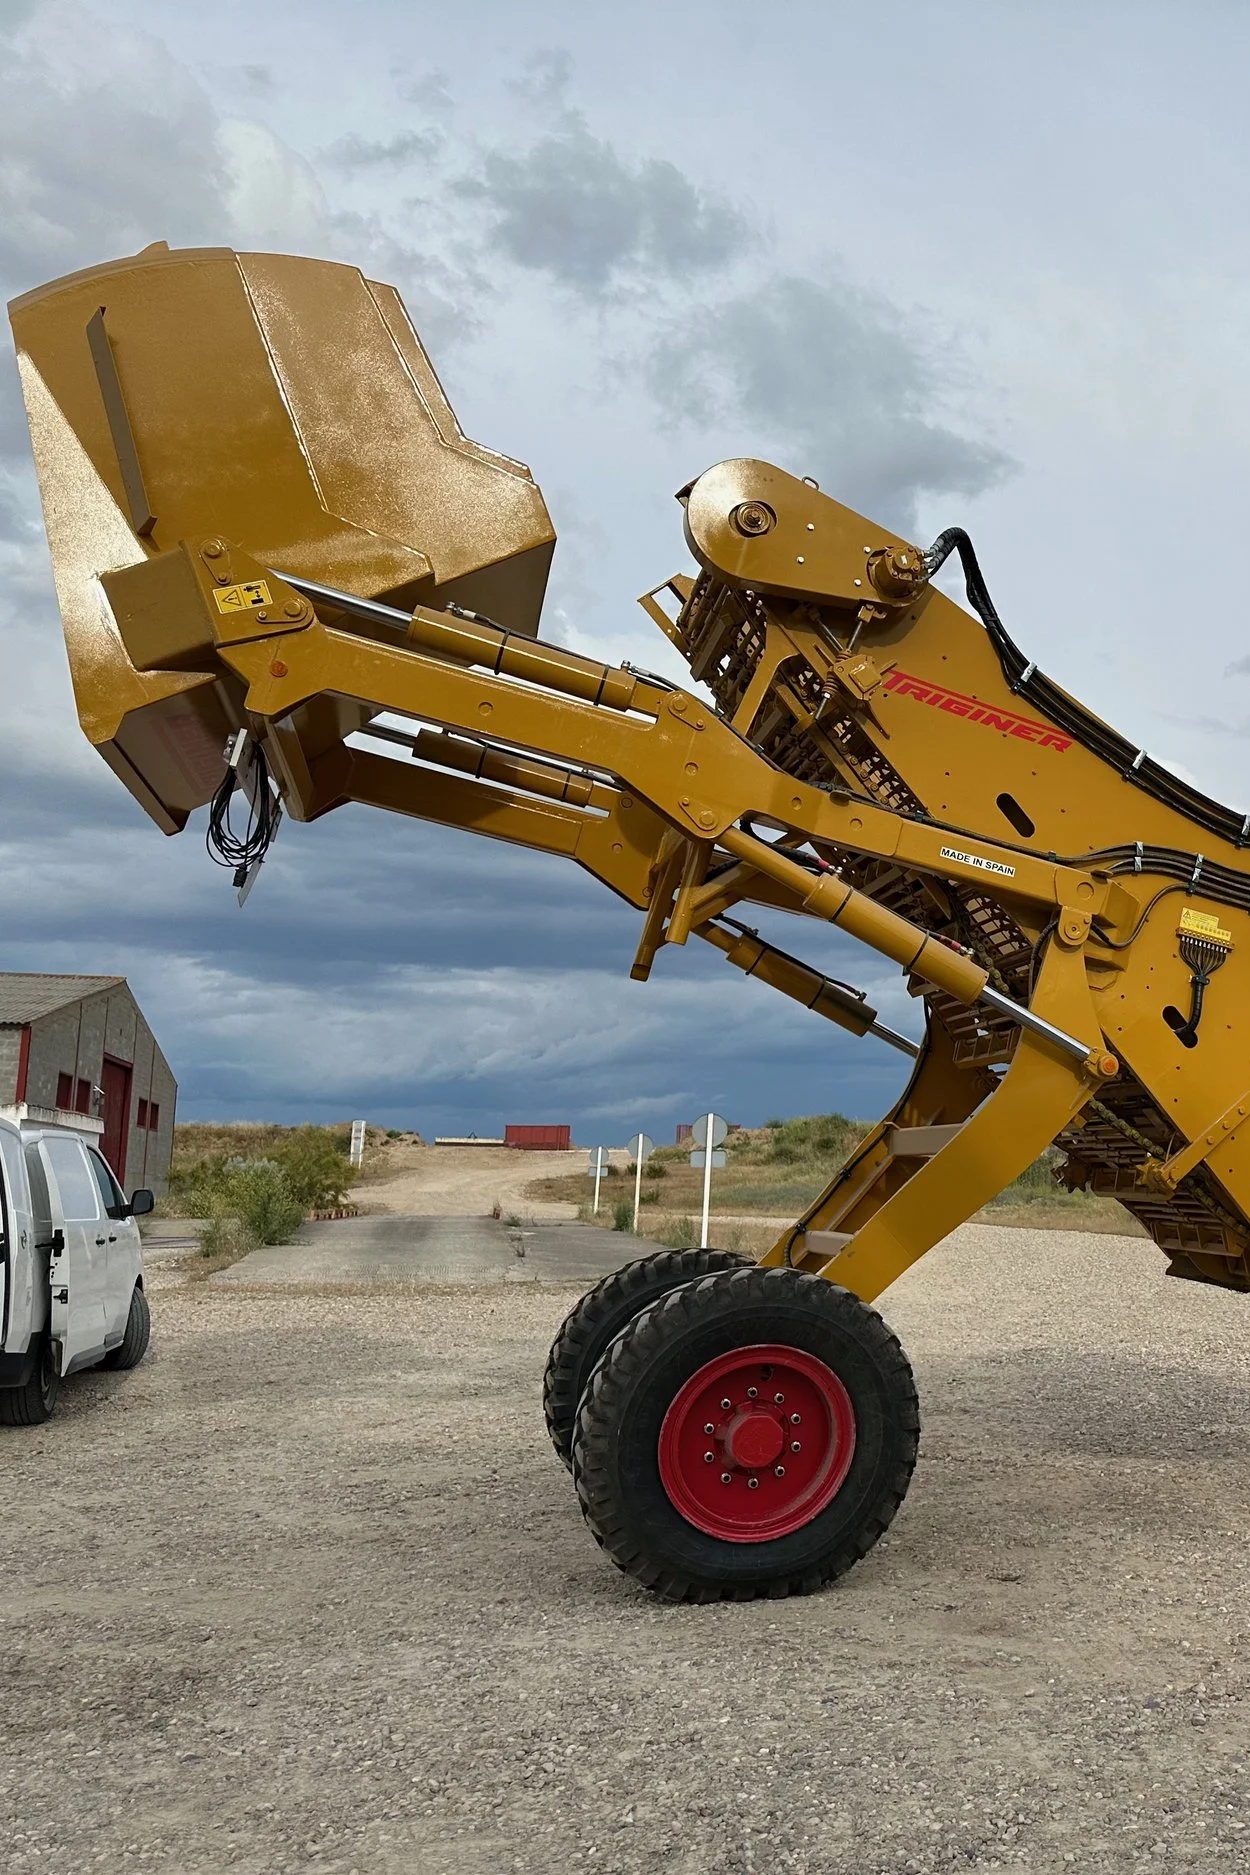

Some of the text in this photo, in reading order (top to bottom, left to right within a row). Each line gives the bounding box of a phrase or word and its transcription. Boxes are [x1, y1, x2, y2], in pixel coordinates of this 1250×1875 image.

[882, 668, 1075, 753] TRIGINER
[941, 848, 1015, 875] MADE IN SPAIN
